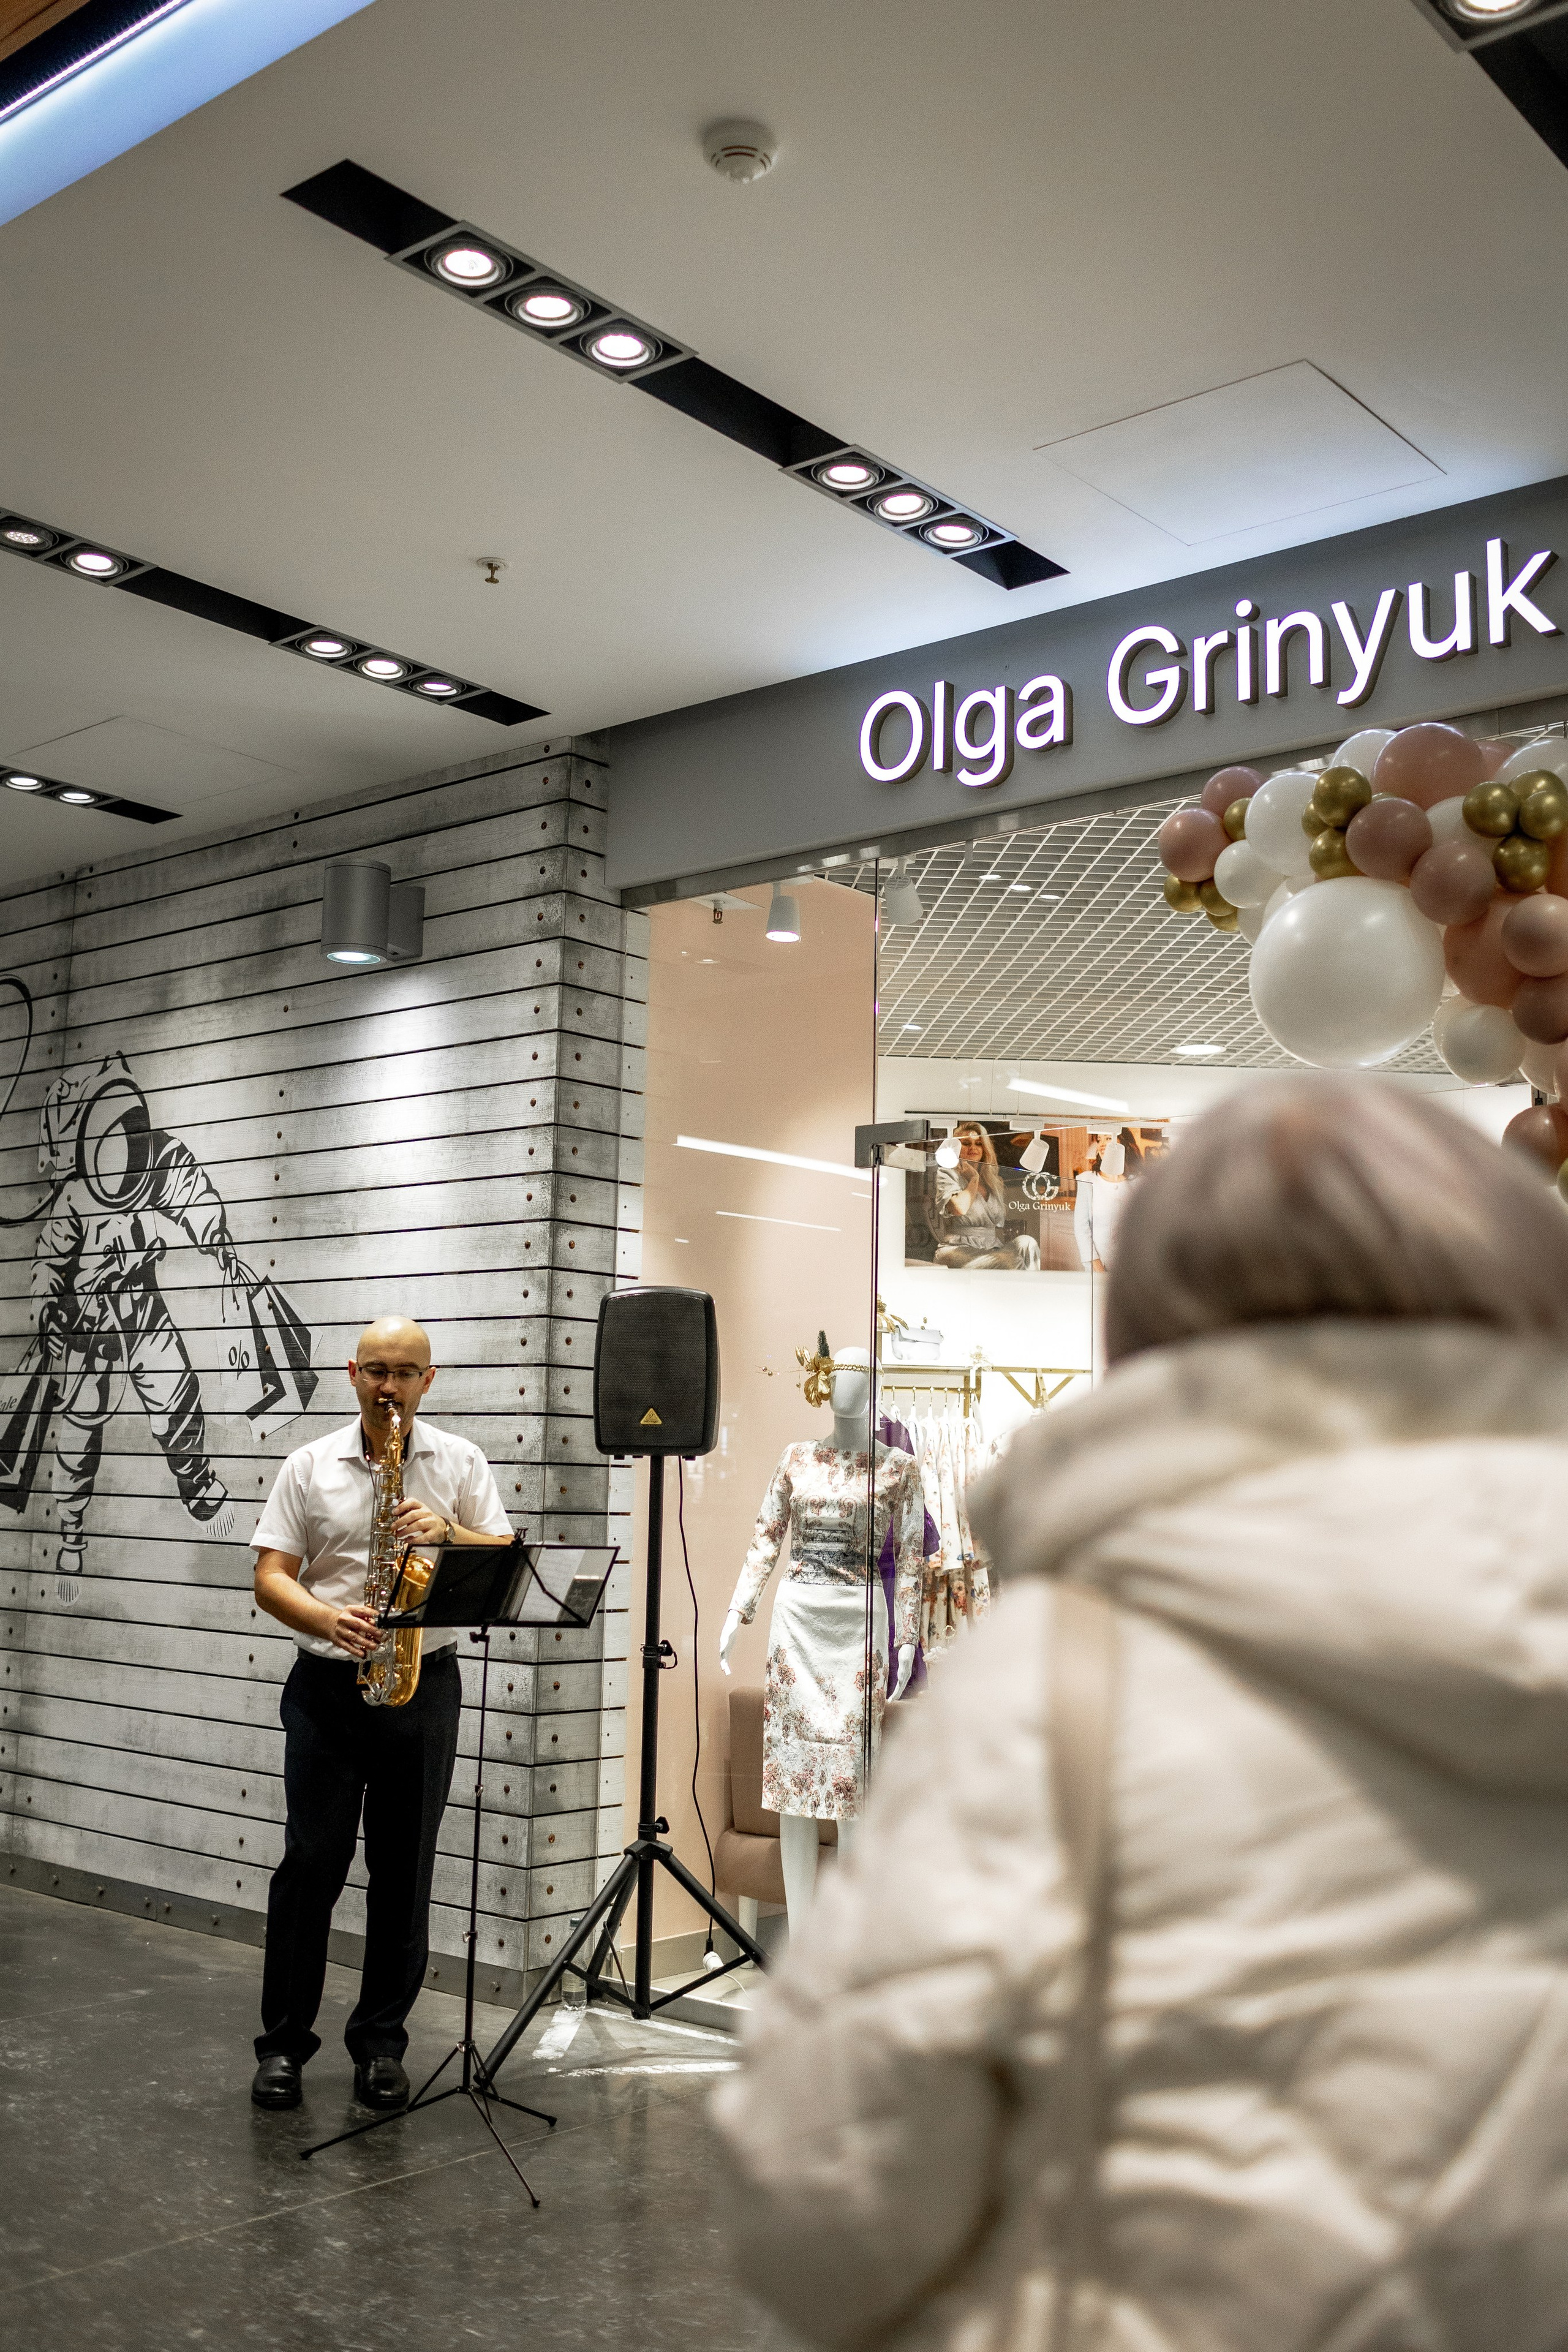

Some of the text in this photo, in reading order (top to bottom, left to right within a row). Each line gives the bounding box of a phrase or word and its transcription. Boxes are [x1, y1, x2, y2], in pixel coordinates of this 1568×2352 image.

[859, 537, 1559, 788] Olga Grinyuk
[1008, 1200, 1071, 1213] Olga Grinyuk
[0, 1396, 17, 1411] ale
